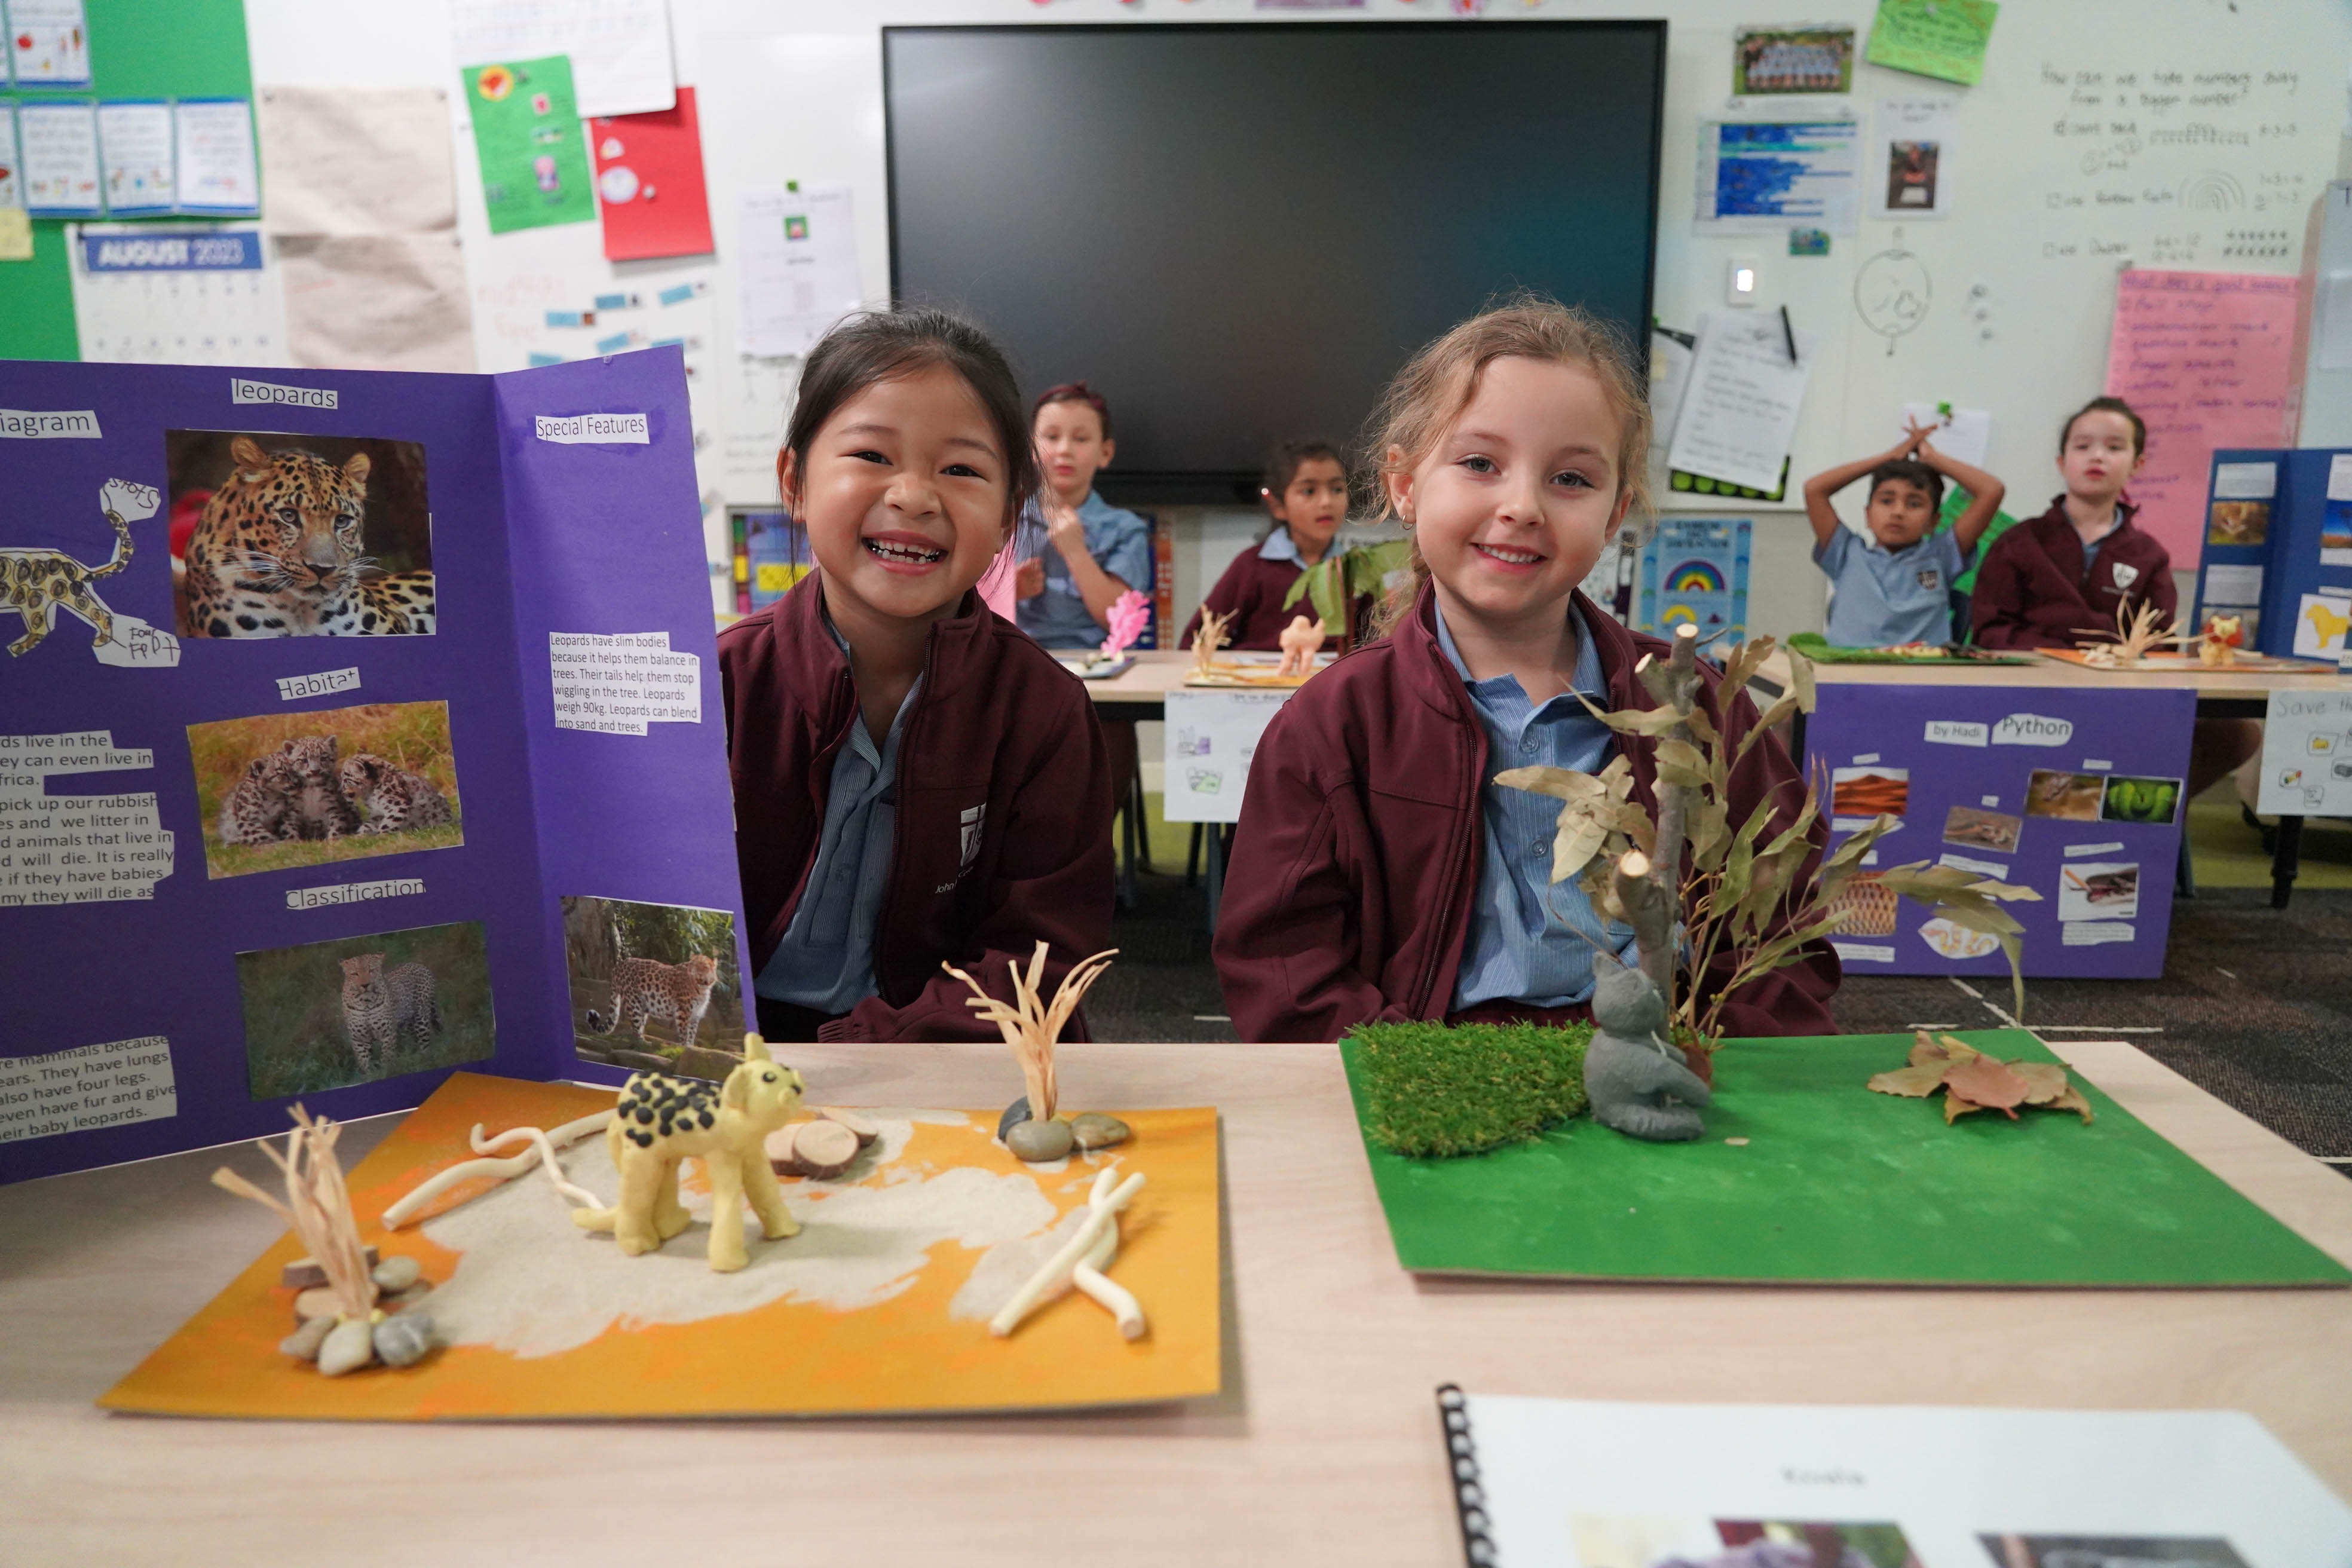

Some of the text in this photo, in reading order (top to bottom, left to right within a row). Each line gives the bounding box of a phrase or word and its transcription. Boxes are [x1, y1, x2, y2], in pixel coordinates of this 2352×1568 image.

[98, 241, 189, 267] AUGUST
[236, 378, 335, 407] leopards
[538, 417, 644, 440] Special Features
[551, 635, 666, 647] Leopards have slim bodies
[552, 651, 697, 666] because it helps them balance in
[553, 669, 577, 679] trees.
[580, 669, 602, 679] Their
[605, 670, 623, 681] tails
[647, 672, 671, 682] them
[674, 673, 694, 685] stop
[555, 685, 685, 701] wiggling in the tree. Leopards
[556, 702, 580, 714] weigh
[584, 702, 607, 716] 90kg.
[610, 705, 650, 716] Leopards
[672, 706, 697, 718] blend
[2276, 693, 2325, 717] Save
[556, 719, 643, 732] into sand and trees.
[1933, 716, 2070, 737] by Hadi Python
[26, 736, 54, 747] live
[60, 735, 74, 746] in
[81, 735, 108, 746] the
[25, 757, 53, 766] can
[60, 754, 99, 765] even
[105, 753, 131, 764] live
[138, 752, 152, 764] in
[38, 801, 59, 812] up
[65, 800, 92, 809] our
[99, 795, 158, 808] rubbish
[20, 816, 50, 828] and
[61, 818, 85, 827] we
[91, 814, 129, 826] litter
[135, 814, 148, 825] in
[17, 834, 81, 848] animals
[88, 834, 120, 845] that
[125, 832, 152, 844] live
[158, 831, 171, 843] in
[23, 853, 50, 866] will
[62, 852, 91, 865] die.
[97, 852, 108, 863] It
[114, 851, 124, 862] is
[130, 849, 173, 863] really
[10, 872, 19, 886] if
[25, 871, 62, 886] they
[68, 870, 106, 882] have
[112, 868, 163, 881] babies
[33, 890, 68, 904] they
[74, 887, 102, 900] will
[108, 887, 131, 899] die
[137, 887, 154, 897] as
[287, 880, 425, 908] Classification
[19, 1045, 99, 1067] mammals
[105, 1035, 170, 1053] because
[39, 1066, 79, 1080] They
[85, 1059, 122, 1073] have
[127, 1052, 169, 1066] lungs
[33, 1085, 72, 1099] have
[78, 1079, 110, 1092] four
[116, 1073, 150, 1086] legs.
[41, 1102, 79, 1117] have
[84, 1095, 106, 1108] fur
[112, 1089, 141, 1104] and
[146, 1084, 176, 1101] give
[30, 1120, 69, 1135] baby
[74, 1107, 147, 1127] leopards.
